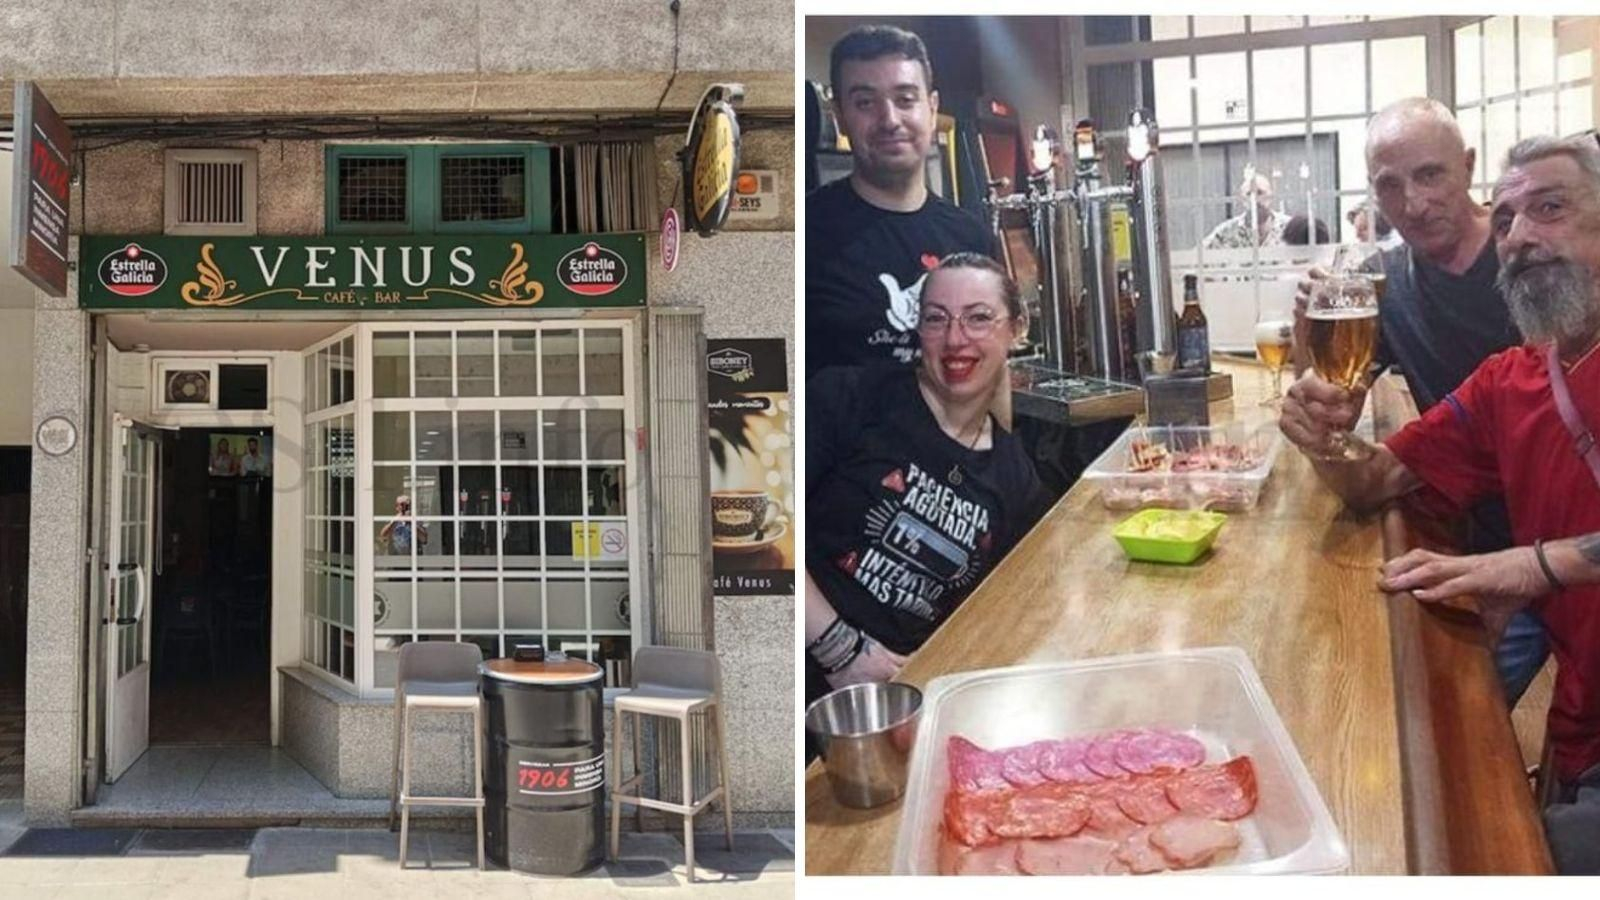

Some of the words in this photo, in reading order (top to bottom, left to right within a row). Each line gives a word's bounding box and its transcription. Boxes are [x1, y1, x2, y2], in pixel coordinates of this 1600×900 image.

[110, 259, 156, 271] Estrella
[249, 246, 476, 287] VENUS
[569, 258, 615, 270] Estrella
[111, 270, 154, 283] Galicia
[570, 270, 614, 282] Galicia
[324, 290, 356, 303] CAFÉ
[375, 292, 401, 303] BAR
[906, 463, 989, 532] PACIENCIA
[893, 521, 920, 554] 1%
[737, 576, 772, 588] Venus
[518, 768, 570, 788] 1906
